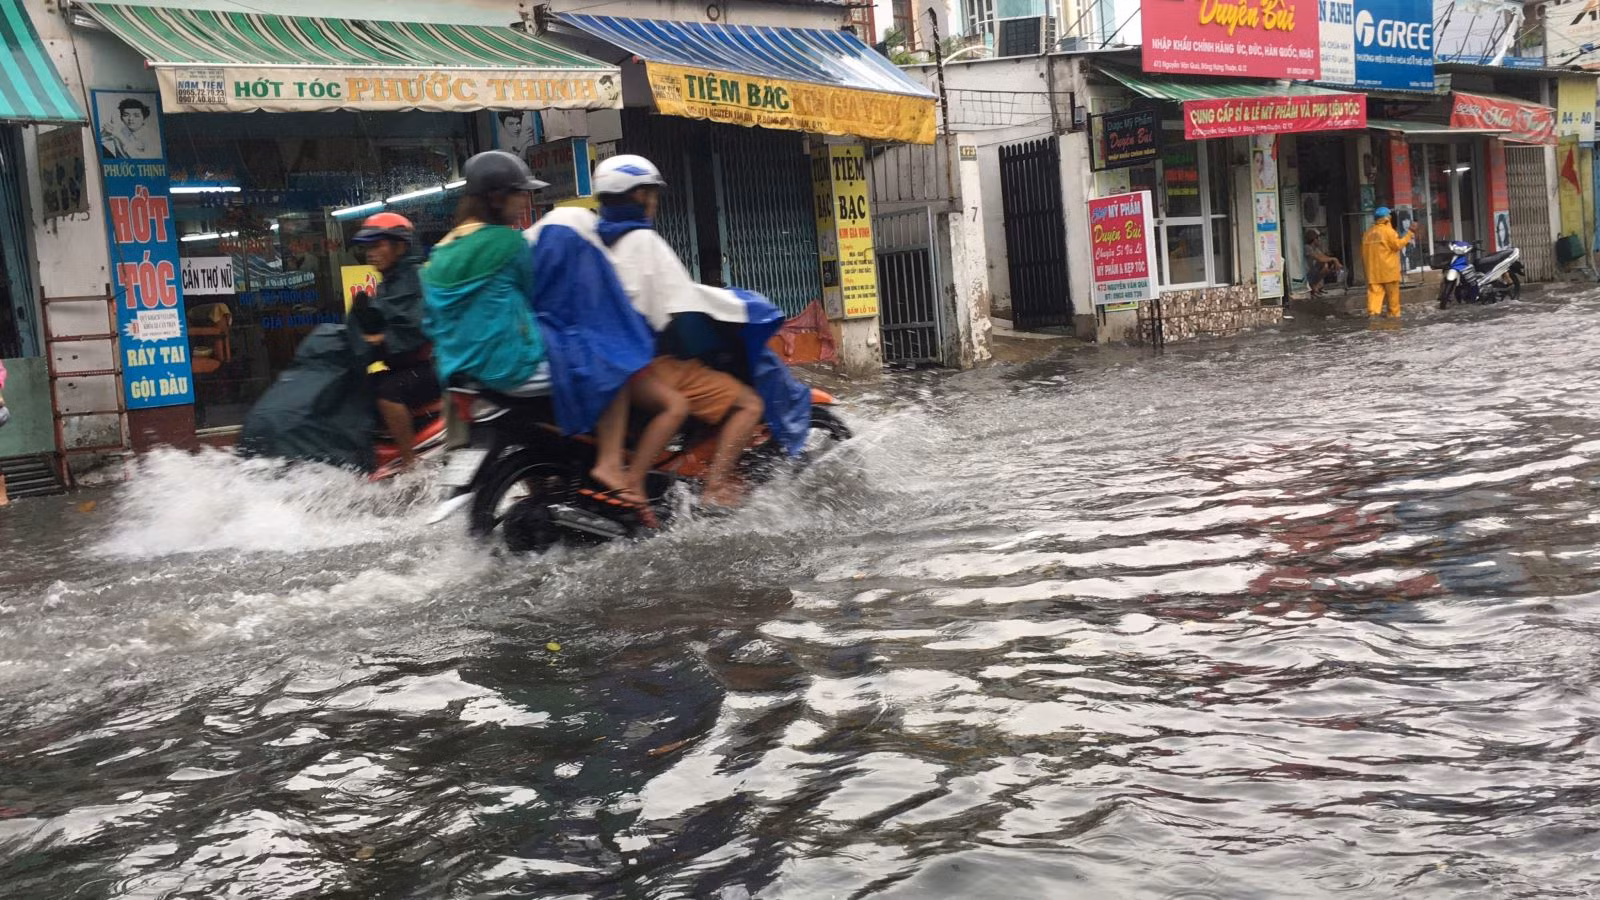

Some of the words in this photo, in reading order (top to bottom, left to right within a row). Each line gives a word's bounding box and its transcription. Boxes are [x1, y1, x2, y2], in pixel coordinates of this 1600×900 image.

[1200, 0, 1259, 36] Duyên
[1262, 0, 1295, 32] Bùi
[1330, 3, 1352, 25] ANH
[1377, 19, 1433, 51] GREE
[178, 81, 199, 89] NAM
[234, 76, 284, 98] HỚT
[293, 75, 342, 98] TÓC
[345, 72, 479, 103] PHƯỚC
[486, 77, 600, 105] THỊNH
[684, 72, 741, 106] TIỆM
[746, 83, 790, 113] BẠC
[1217, 102, 1233, 122] CẤP
[1274, 98, 1299, 119] PHẨM
[1344, 99, 1360, 115] TÓC
[1561, 112, 1573, 125] A4
[103, 162, 137, 177] PHƯỚC
[137, 163, 166, 178] THỊNH
[833, 149, 865, 187] TIỆM
[109, 184, 169, 244] HỚT
[838, 194, 866, 225] BẠC
[1108, 200, 1119, 218] MỸ
[1120, 195, 1141, 217] PHẨM
[1094, 224, 1121, 246] Duyên
[1125, 220, 1142, 240] Bùi
[117, 250, 178, 309] TÓC
[182, 260, 200, 290] CẦN
[200, 269, 219, 292] THỢ
[220, 263, 232, 289] NỮ
[126, 344, 156, 367] RÁY
[159, 345, 186, 364] TAI
[131, 375, 157, 402] GỘI
[159, 371, 188, 396] ĐẦU
